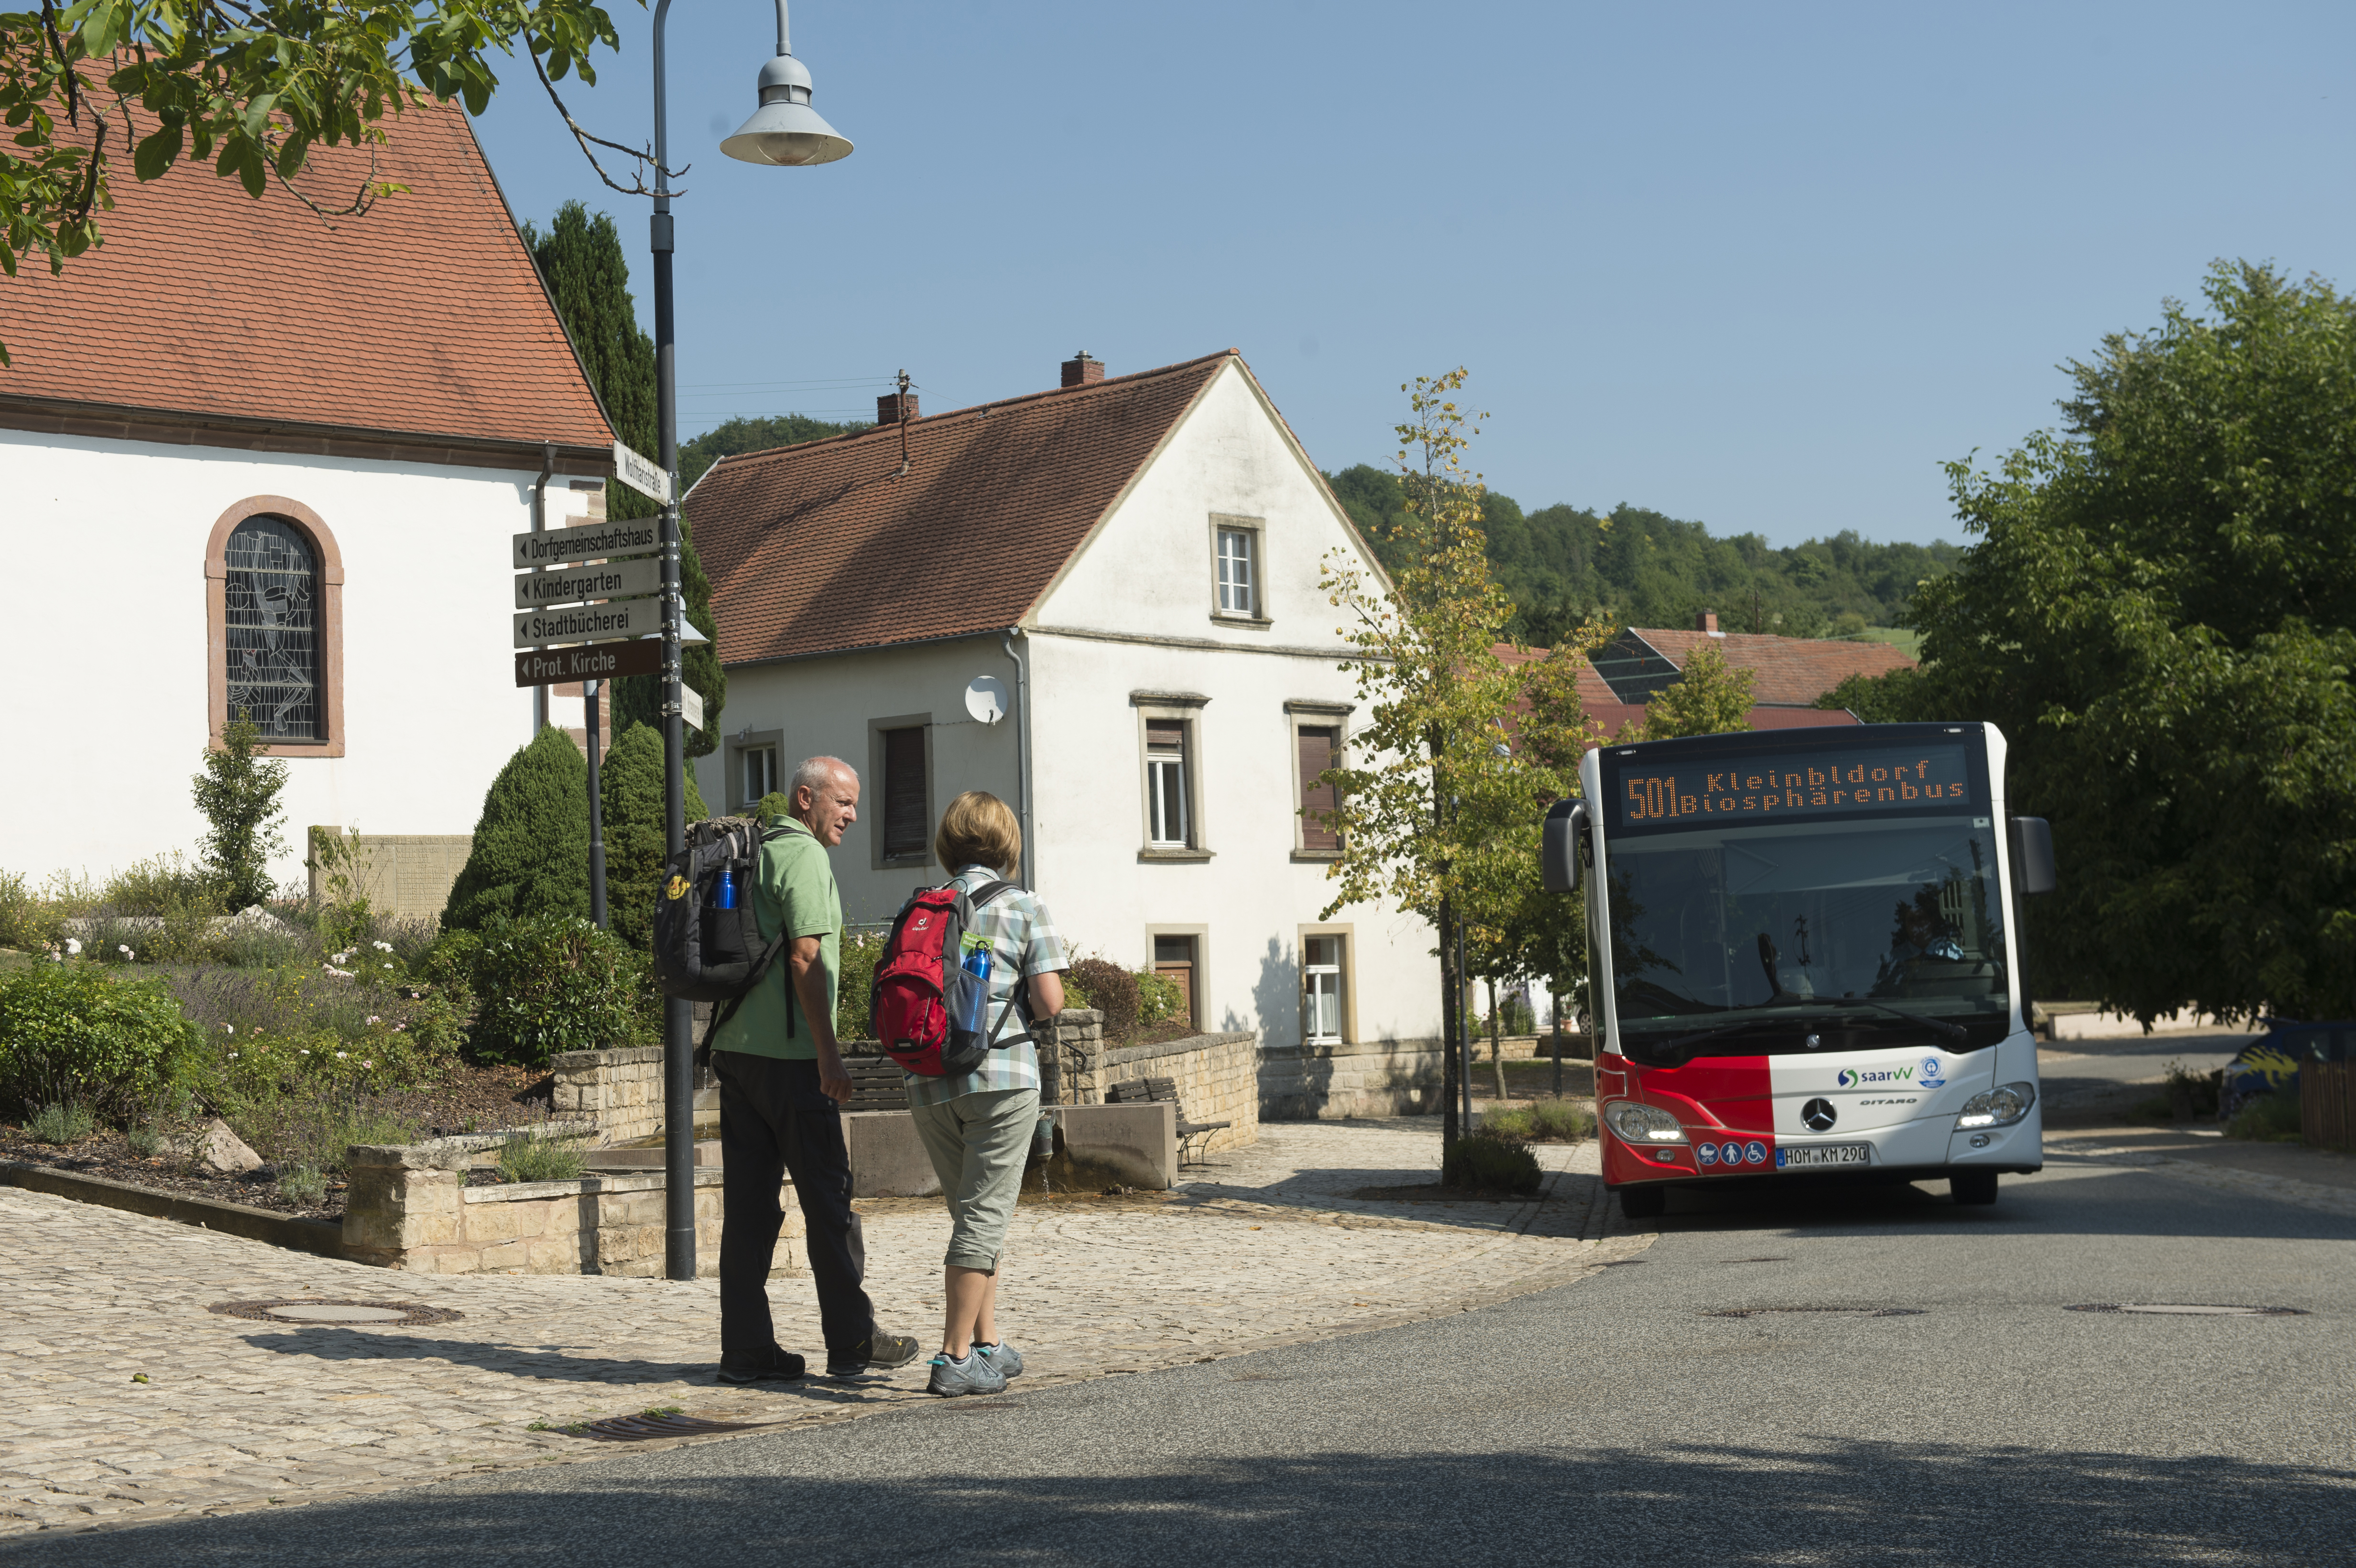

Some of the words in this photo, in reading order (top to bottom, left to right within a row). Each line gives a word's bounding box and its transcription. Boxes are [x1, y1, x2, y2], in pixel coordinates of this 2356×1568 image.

[624, 453, 661, 494] Wolfharistraße
[532, 526, 653, 562] Dorfgemeinschaftshaus
[534, 572, 622, 599] Kindergarten
[533, 608, 629, 638] Stadtbücherei
[534, 656, 566, 678] Prot.
[571, 651, 615, 674] Kirche
[1629, 776, 1679, 818] 501
[1681, 782, 1963, 814] Biosphärenbus
[1785, 1149, 1811, 1164] HOM
[1821, 1147, 1839, 1163] KM
[1842, 1147, 1866, 1162] 290
